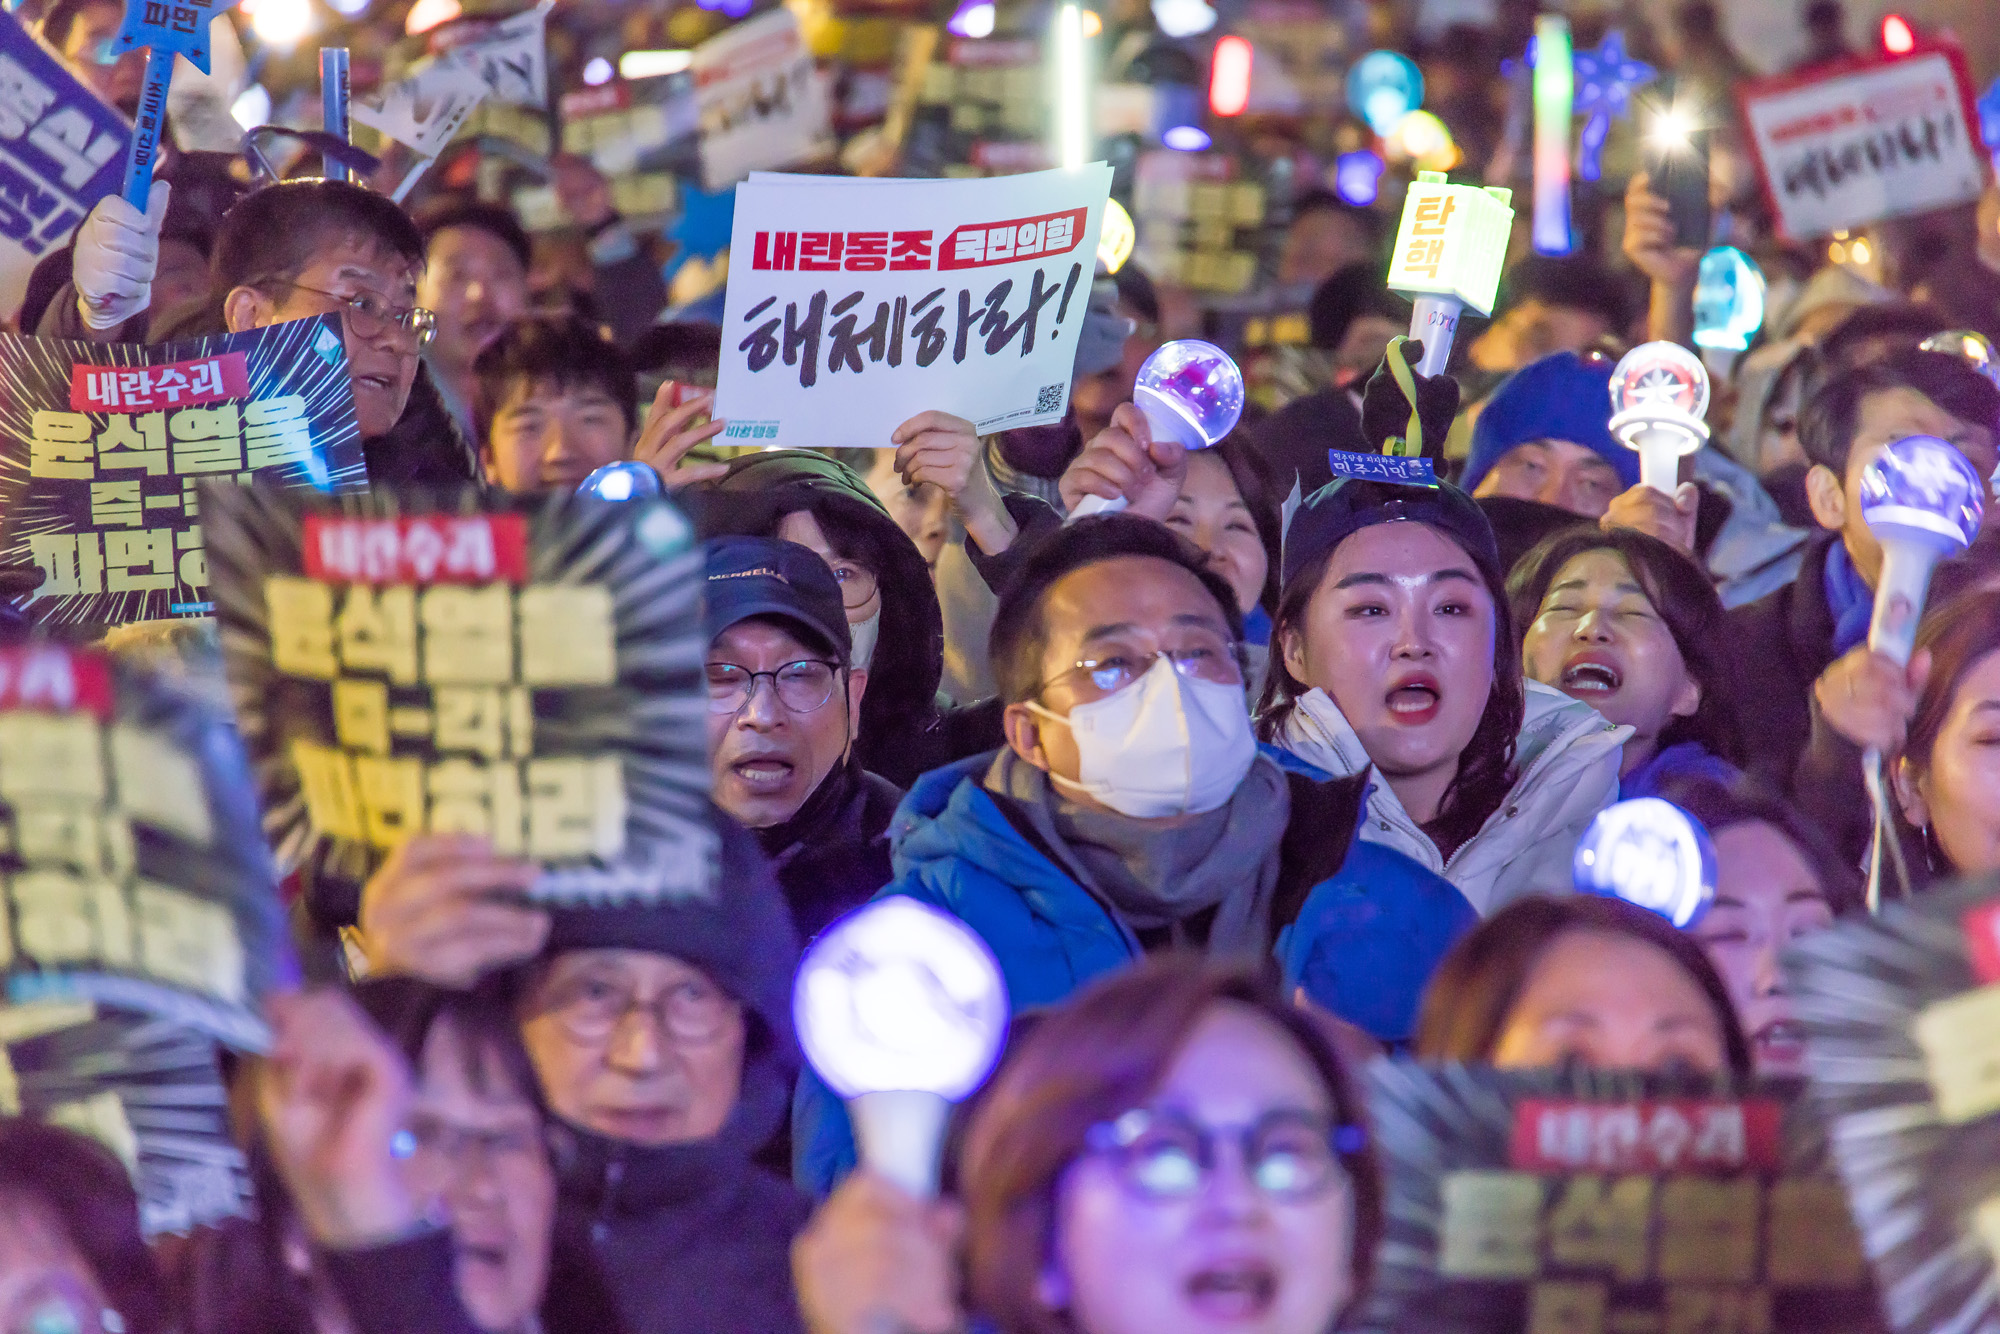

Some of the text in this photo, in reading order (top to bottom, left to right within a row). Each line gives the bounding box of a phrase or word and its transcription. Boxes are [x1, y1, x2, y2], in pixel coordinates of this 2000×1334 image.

[143, 1, 199, 34] 파면
[752, 214, 1077, 272] 내란동조 국민의힘
[1404, 195, 1456, 280] 탄핵
[738, 262, 1083, 388] 해체하라!
[86, 360, 224, 407] 내란수괴
[30, 394, 314, 480] 윤석열을
[1333, 452, 1364, 464] 민주당을
[1333, 460, 1410, 479] 민주시민
